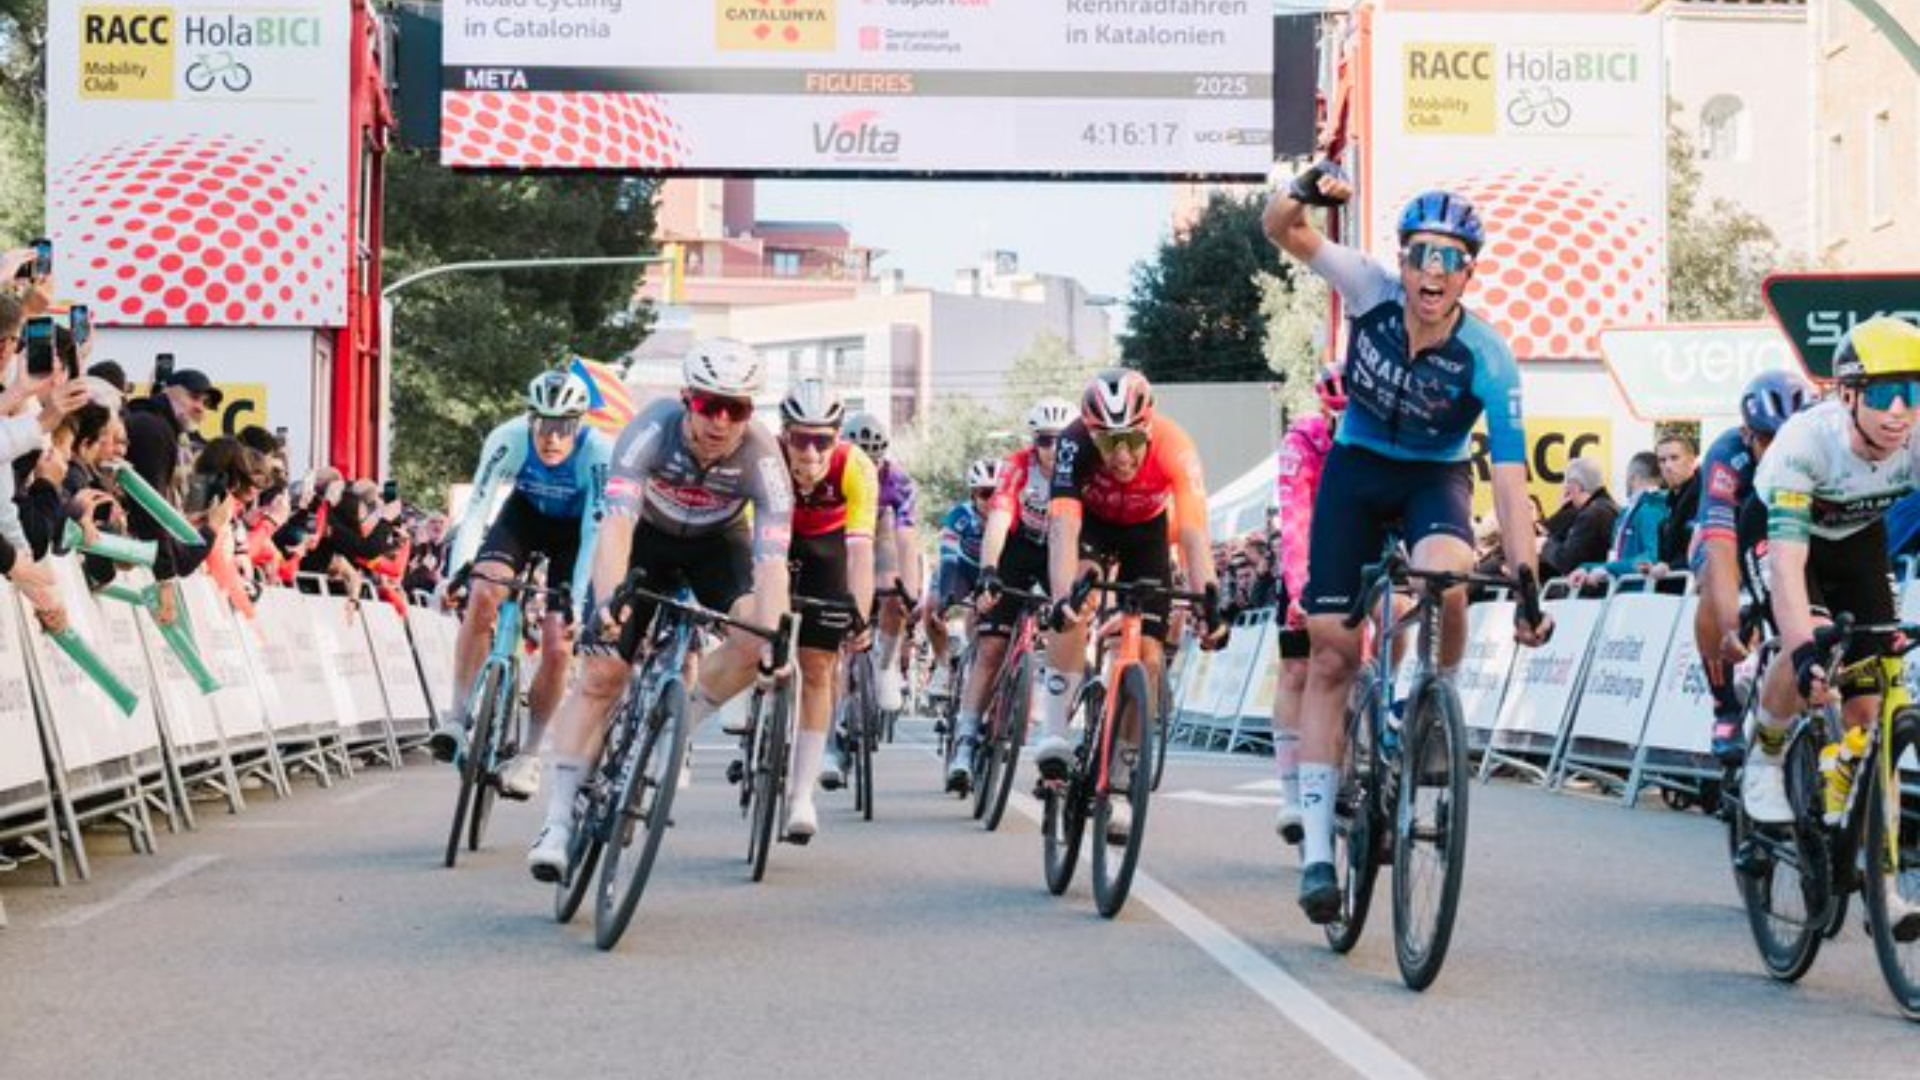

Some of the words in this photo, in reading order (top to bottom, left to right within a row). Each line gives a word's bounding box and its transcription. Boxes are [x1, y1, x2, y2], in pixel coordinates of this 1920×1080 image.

[724, 8, 827, 22] CATALUNYA
[85, 15, 169, 45] RACC
[185, 15, 322, 46] HolaBICI
[465, 18, 487, 38] in
[494, 17, 611, 39] Catalonia
[1066, 25, 1088, 44] in
[1095, 24, 1226, 45] Katalonien
[84, 61, 147, 78] Mobility
[1409, 51, 1490, 80] RACC
[1506, 50, 1638, 82] HolaBICI
[84, 77, 119, 92] Club
[465, 70, 528, 89] META
[806, 74, 914, 93] FIGUERES
[1195, 76, 1248, 96] 2025
[1408, 97, 1470, 114] Mobility
[812, 122, 900, 154] Volta
[1081, 121, 1179, 146] 4:16:17
